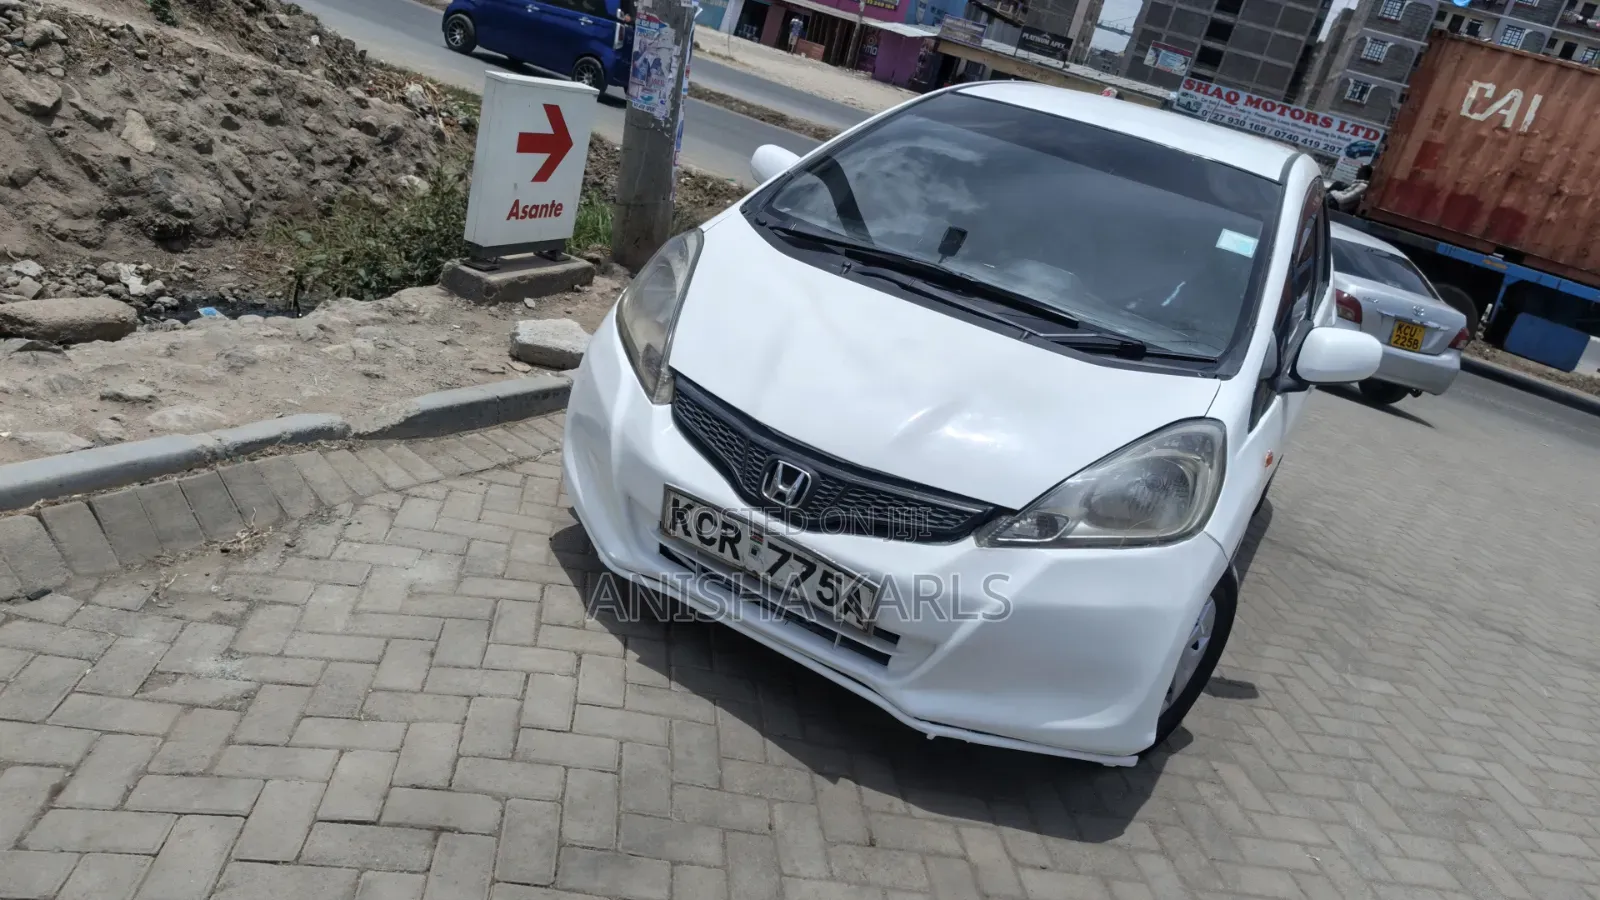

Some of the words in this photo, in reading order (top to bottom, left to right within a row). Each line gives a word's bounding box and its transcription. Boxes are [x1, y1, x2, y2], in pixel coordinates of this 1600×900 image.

[1182, 78, 1240, 105] SHAQ
[1243, 95, 1333, 128] MOTORS
[1336, 120, 1380, 141] LTD
[1460, 80, 1543, 132] CAI
[1227, 116, 1246, 127] 930
[1249, 122, 1267, 133] 168
[1274, 129, 1299, 142] 0740
[1301, 137, 1320, 148] 419
[1322, 143, 1342, 153] 297
[506, 199, 563, 221] Asante
[1396, 323, 1418, 337] KCU
[670, 497, 742, 561] KCR
